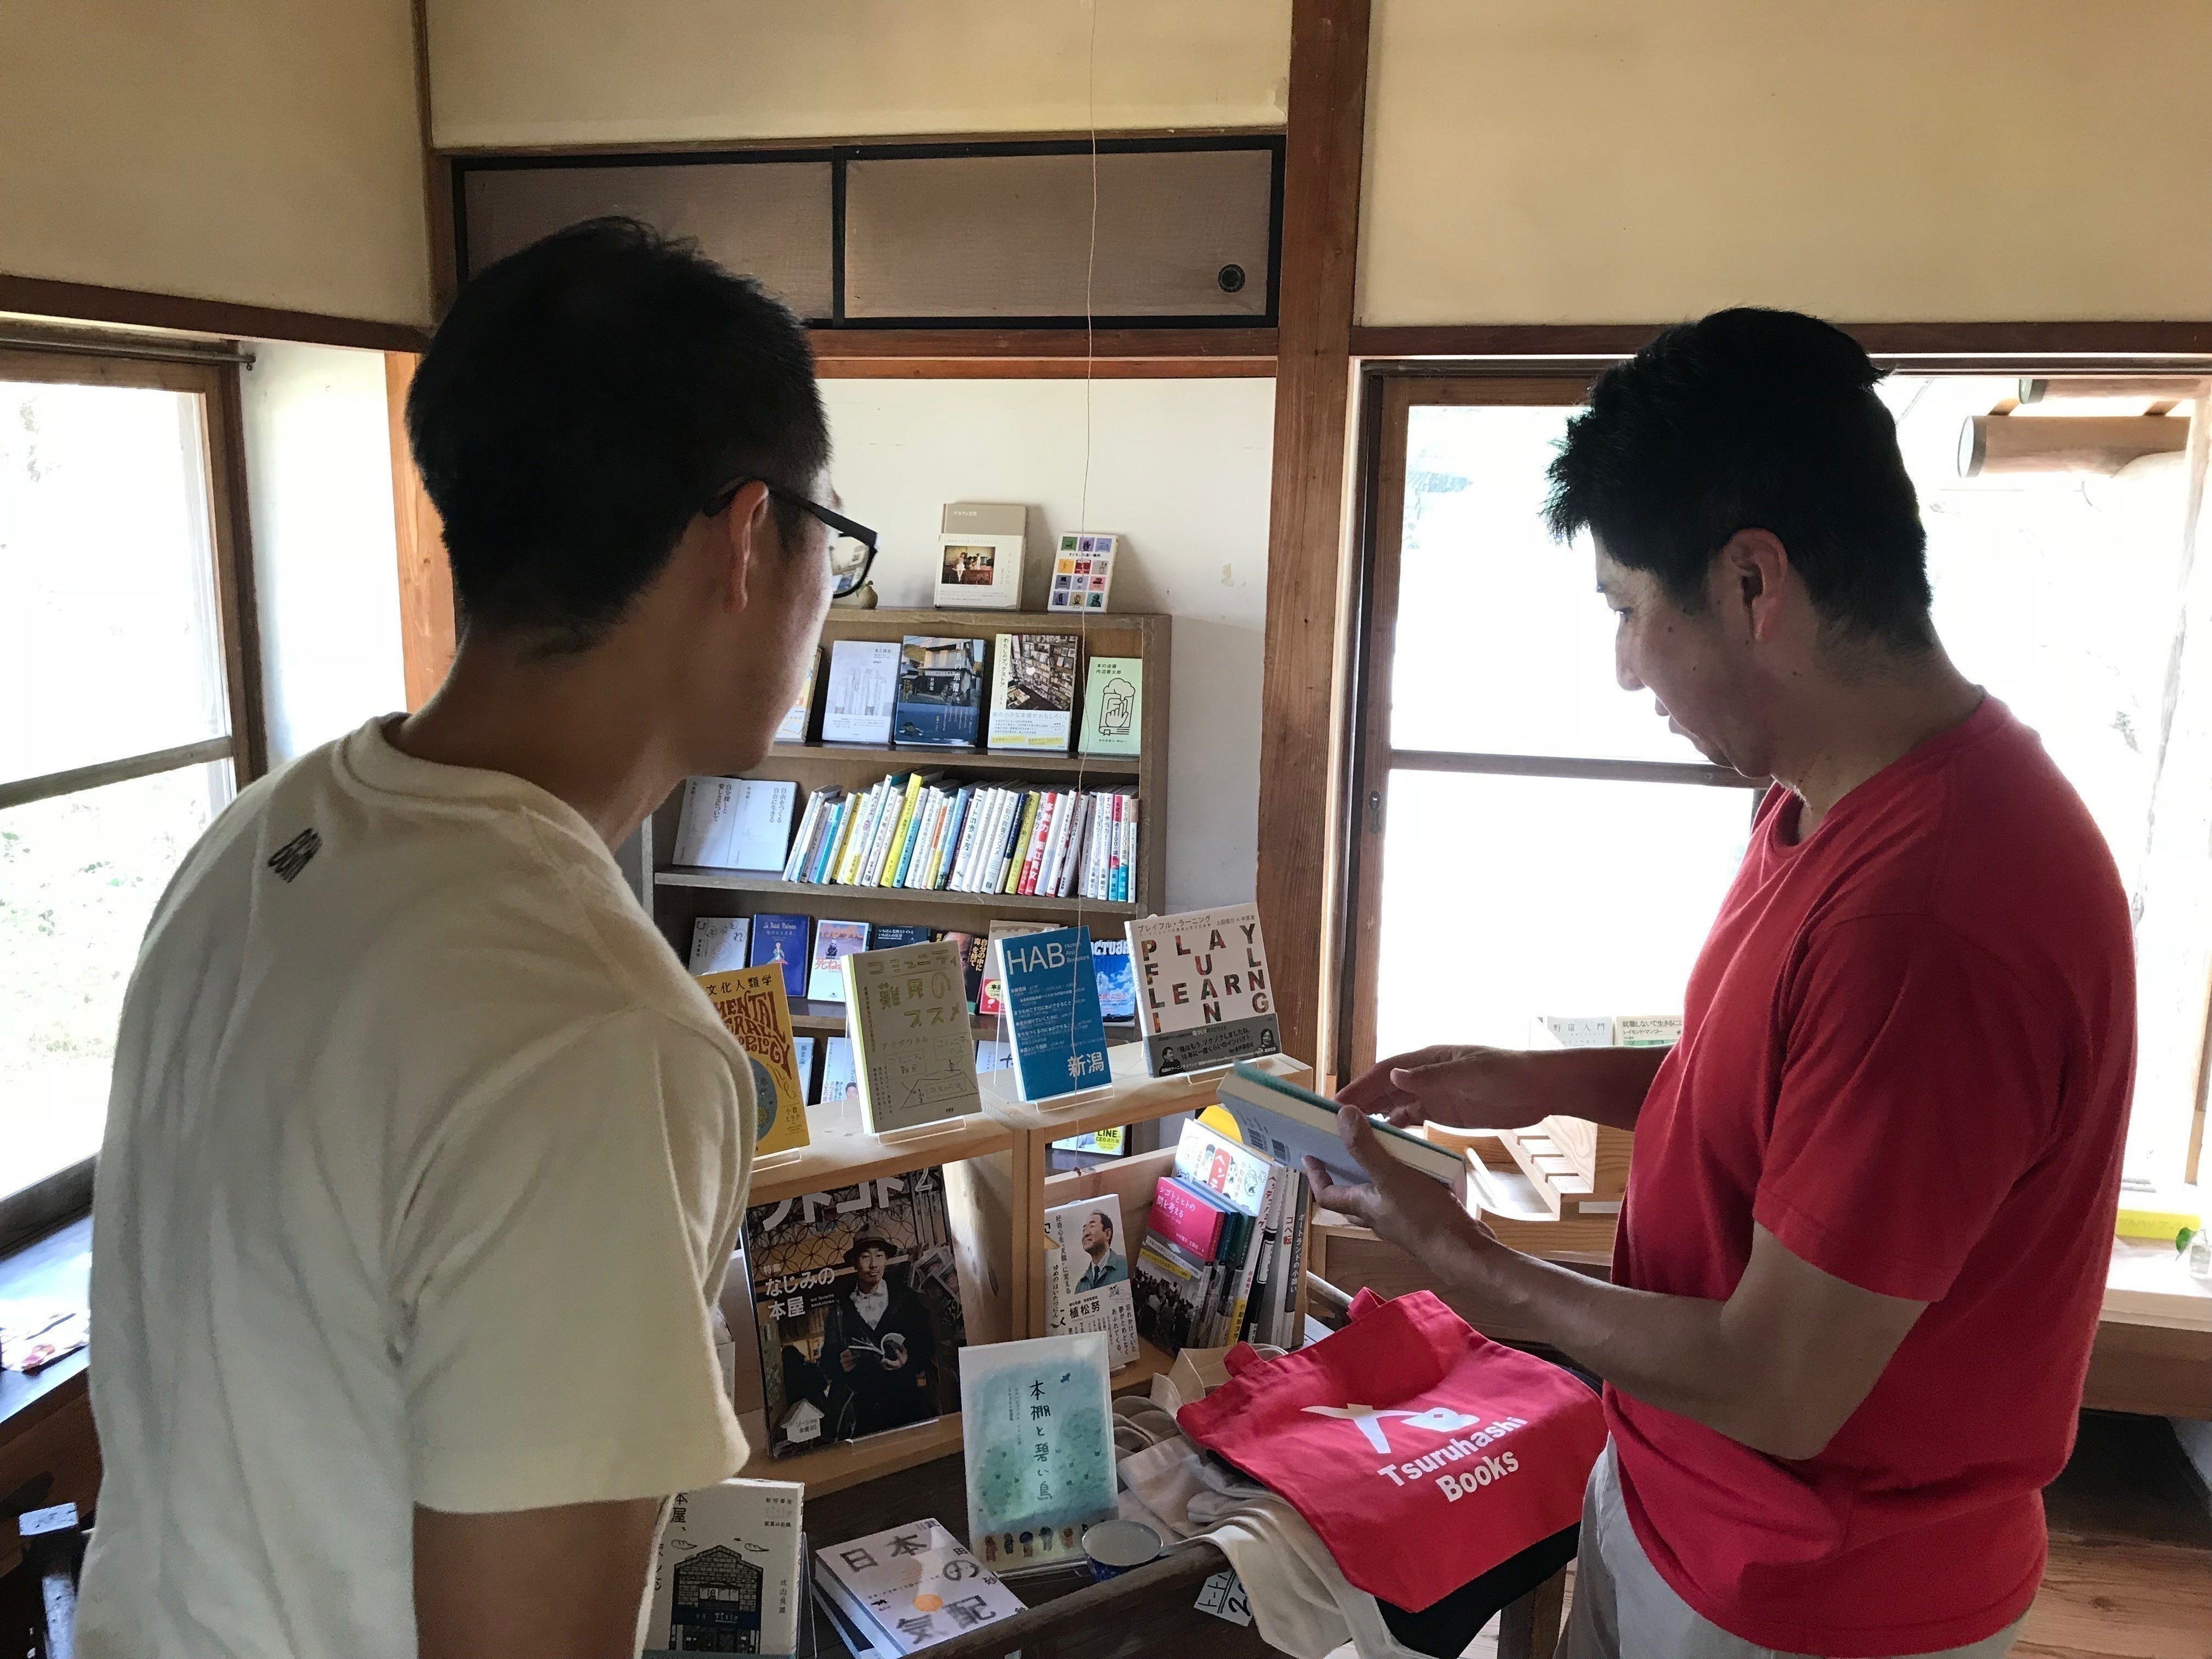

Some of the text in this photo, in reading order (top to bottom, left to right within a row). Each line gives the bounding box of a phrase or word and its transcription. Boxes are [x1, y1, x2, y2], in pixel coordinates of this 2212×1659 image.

[1000, 637, 1009, 687] わたしのブックストア
[769, 787, 780, 823] 自在に生きる
[776, 787, 787, 823] 自由をつくる
[1137, 915, 1211, 933] プレイフル・ラーニング
[975, 938, 988, 972] 自分の中に
[1006, 942, 1065, 975] HAB
[706, 974, 772, 996] 文化人類学
[904, 1001, 961, 1029] ススメ
[1553, 1023, 1605, 1032] 野宿入門
[1066, 1051, 1105, 1078] 新潟
[1097, 1129, 1118, 1138] LINE
[1159, 1186, 1197, 1212] シゴトとヒトの
[763, 1263, 782, 1275] 特集
[765, 1267, 836, 1297] なじみの
[768, 1295, 806, 1321] 本屋
[1069, 1300, 1101, 1319] 植松努
[1118, 1305, 1129, 1356] 夢がとめどなく
[1125, 1303, 1137, 1353] 忘れかけていた
[1029, 1380, 1053, 1501] 本棚と碧い鳥
[1376, 1416, 1528, 1487] Tsuruhashi
[1435, 1451, 1519, 1503] Books
